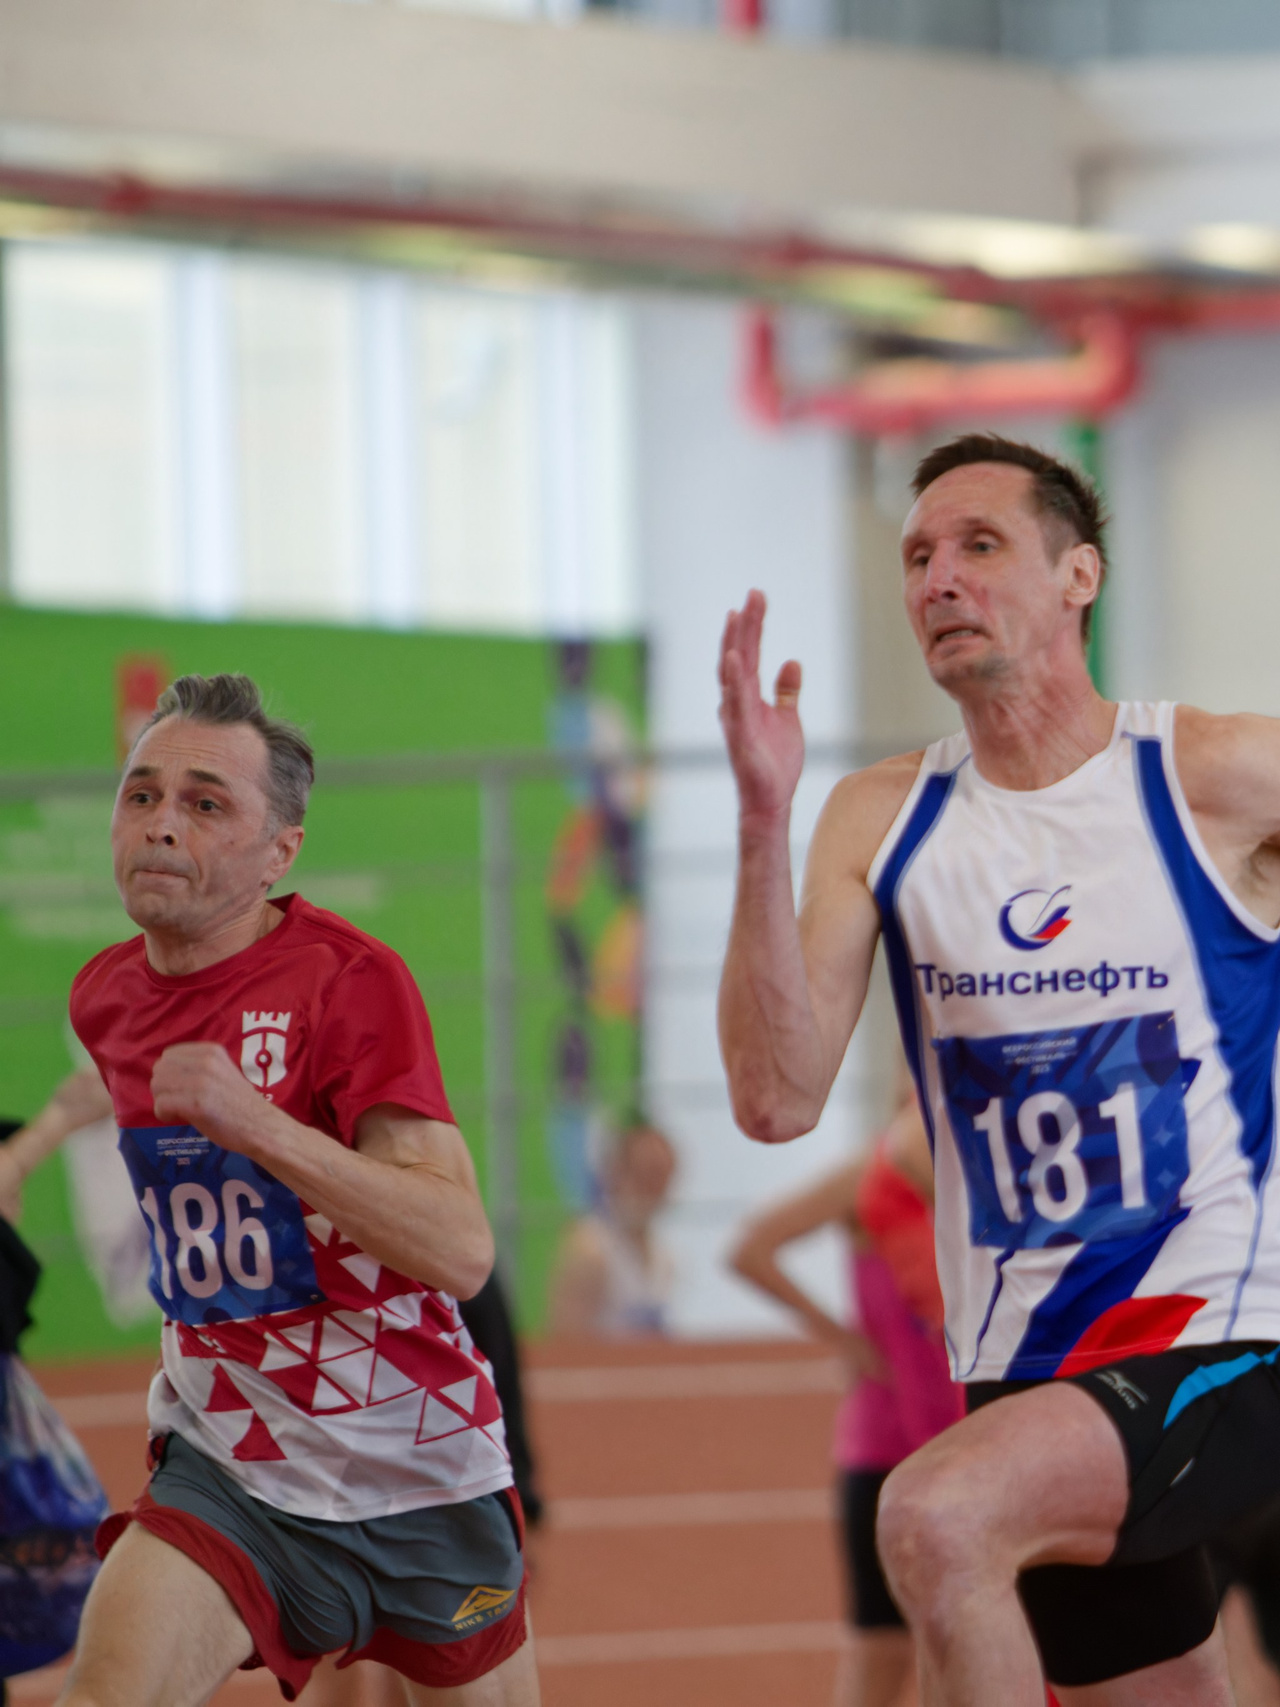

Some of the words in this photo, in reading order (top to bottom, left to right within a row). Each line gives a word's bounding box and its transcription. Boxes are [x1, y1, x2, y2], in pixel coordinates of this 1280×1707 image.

[915, 959, 1170, 1002] Транснефть
[973, 1081, 1146, 1224] 181
[140, 1178, 274, 1300] 186
[455, 1615, 484, 1631] NIKE
